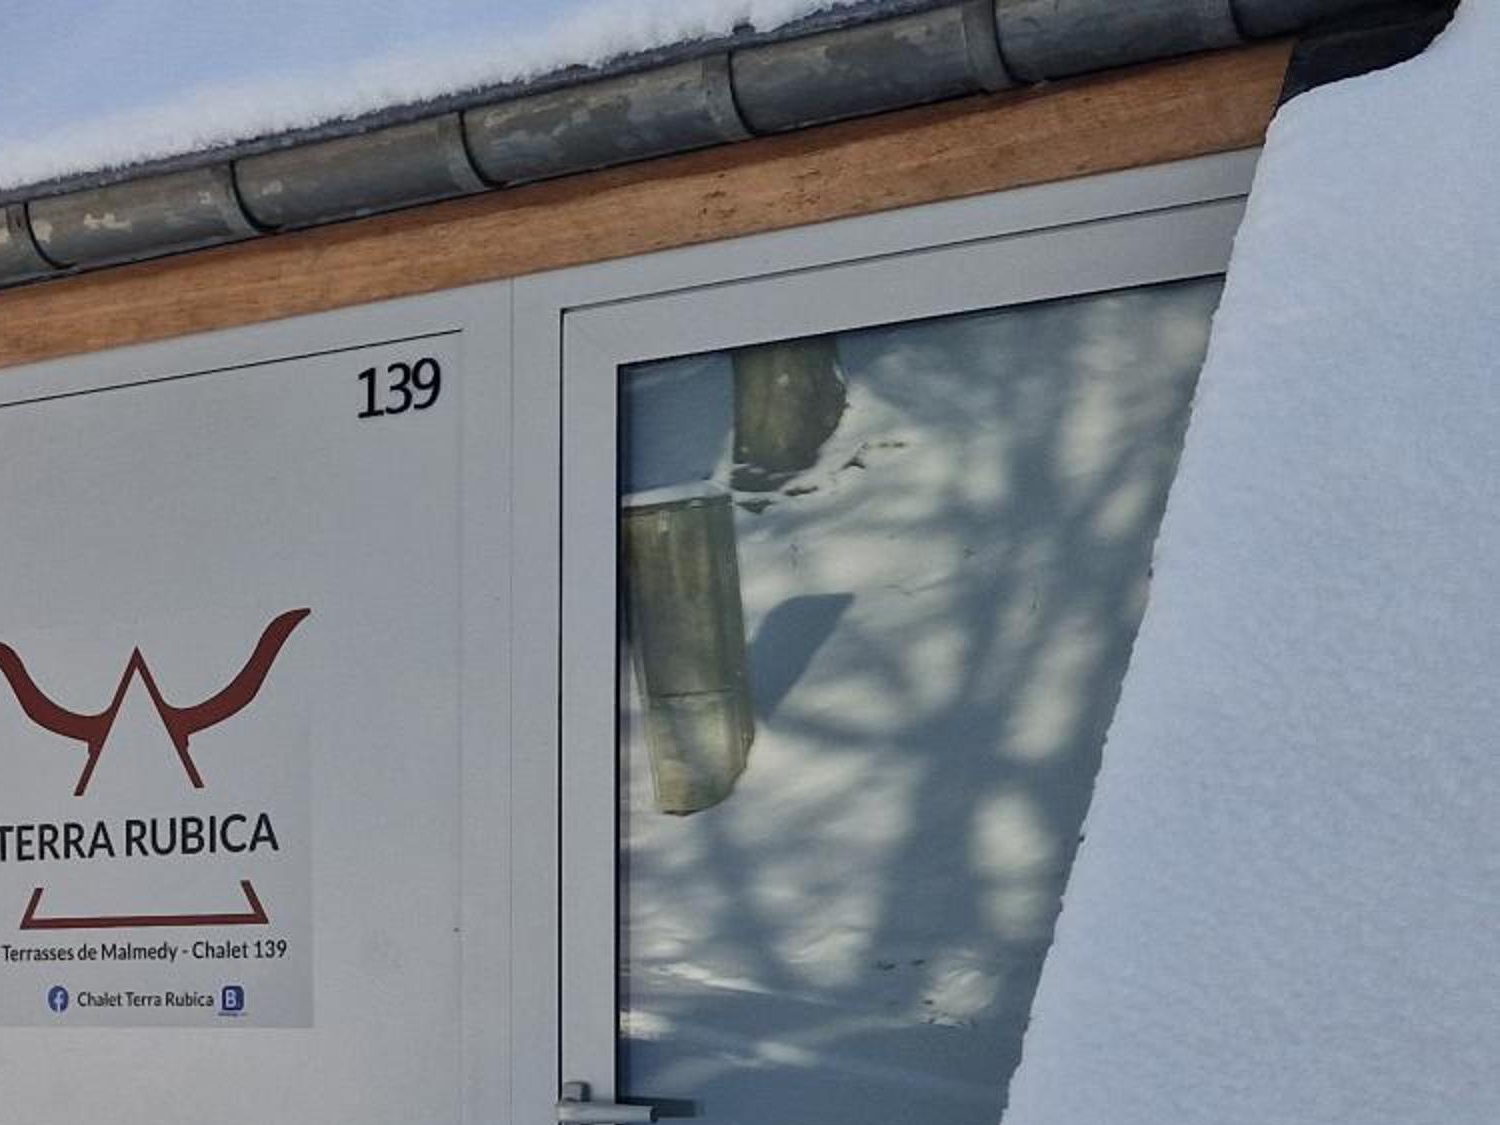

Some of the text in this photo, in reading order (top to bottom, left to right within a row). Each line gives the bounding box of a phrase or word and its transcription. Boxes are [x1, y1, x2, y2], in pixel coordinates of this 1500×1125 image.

[358, 357, 441, 418] 139
[125, 812, 279, 856] RUBICA
[1, 944, 75, 961] Terrasses
[77, 943, 97, 960] de
[101, 942, 178, 963] Malmedy
[192, 940, 249, 959] Chalet
[253, 939, 288, 958] 139
[77, 990, 122, 1007] Chalet
[124, 990, 162, 1007] Terra
[165, 990, 214, 1007] Rubica
